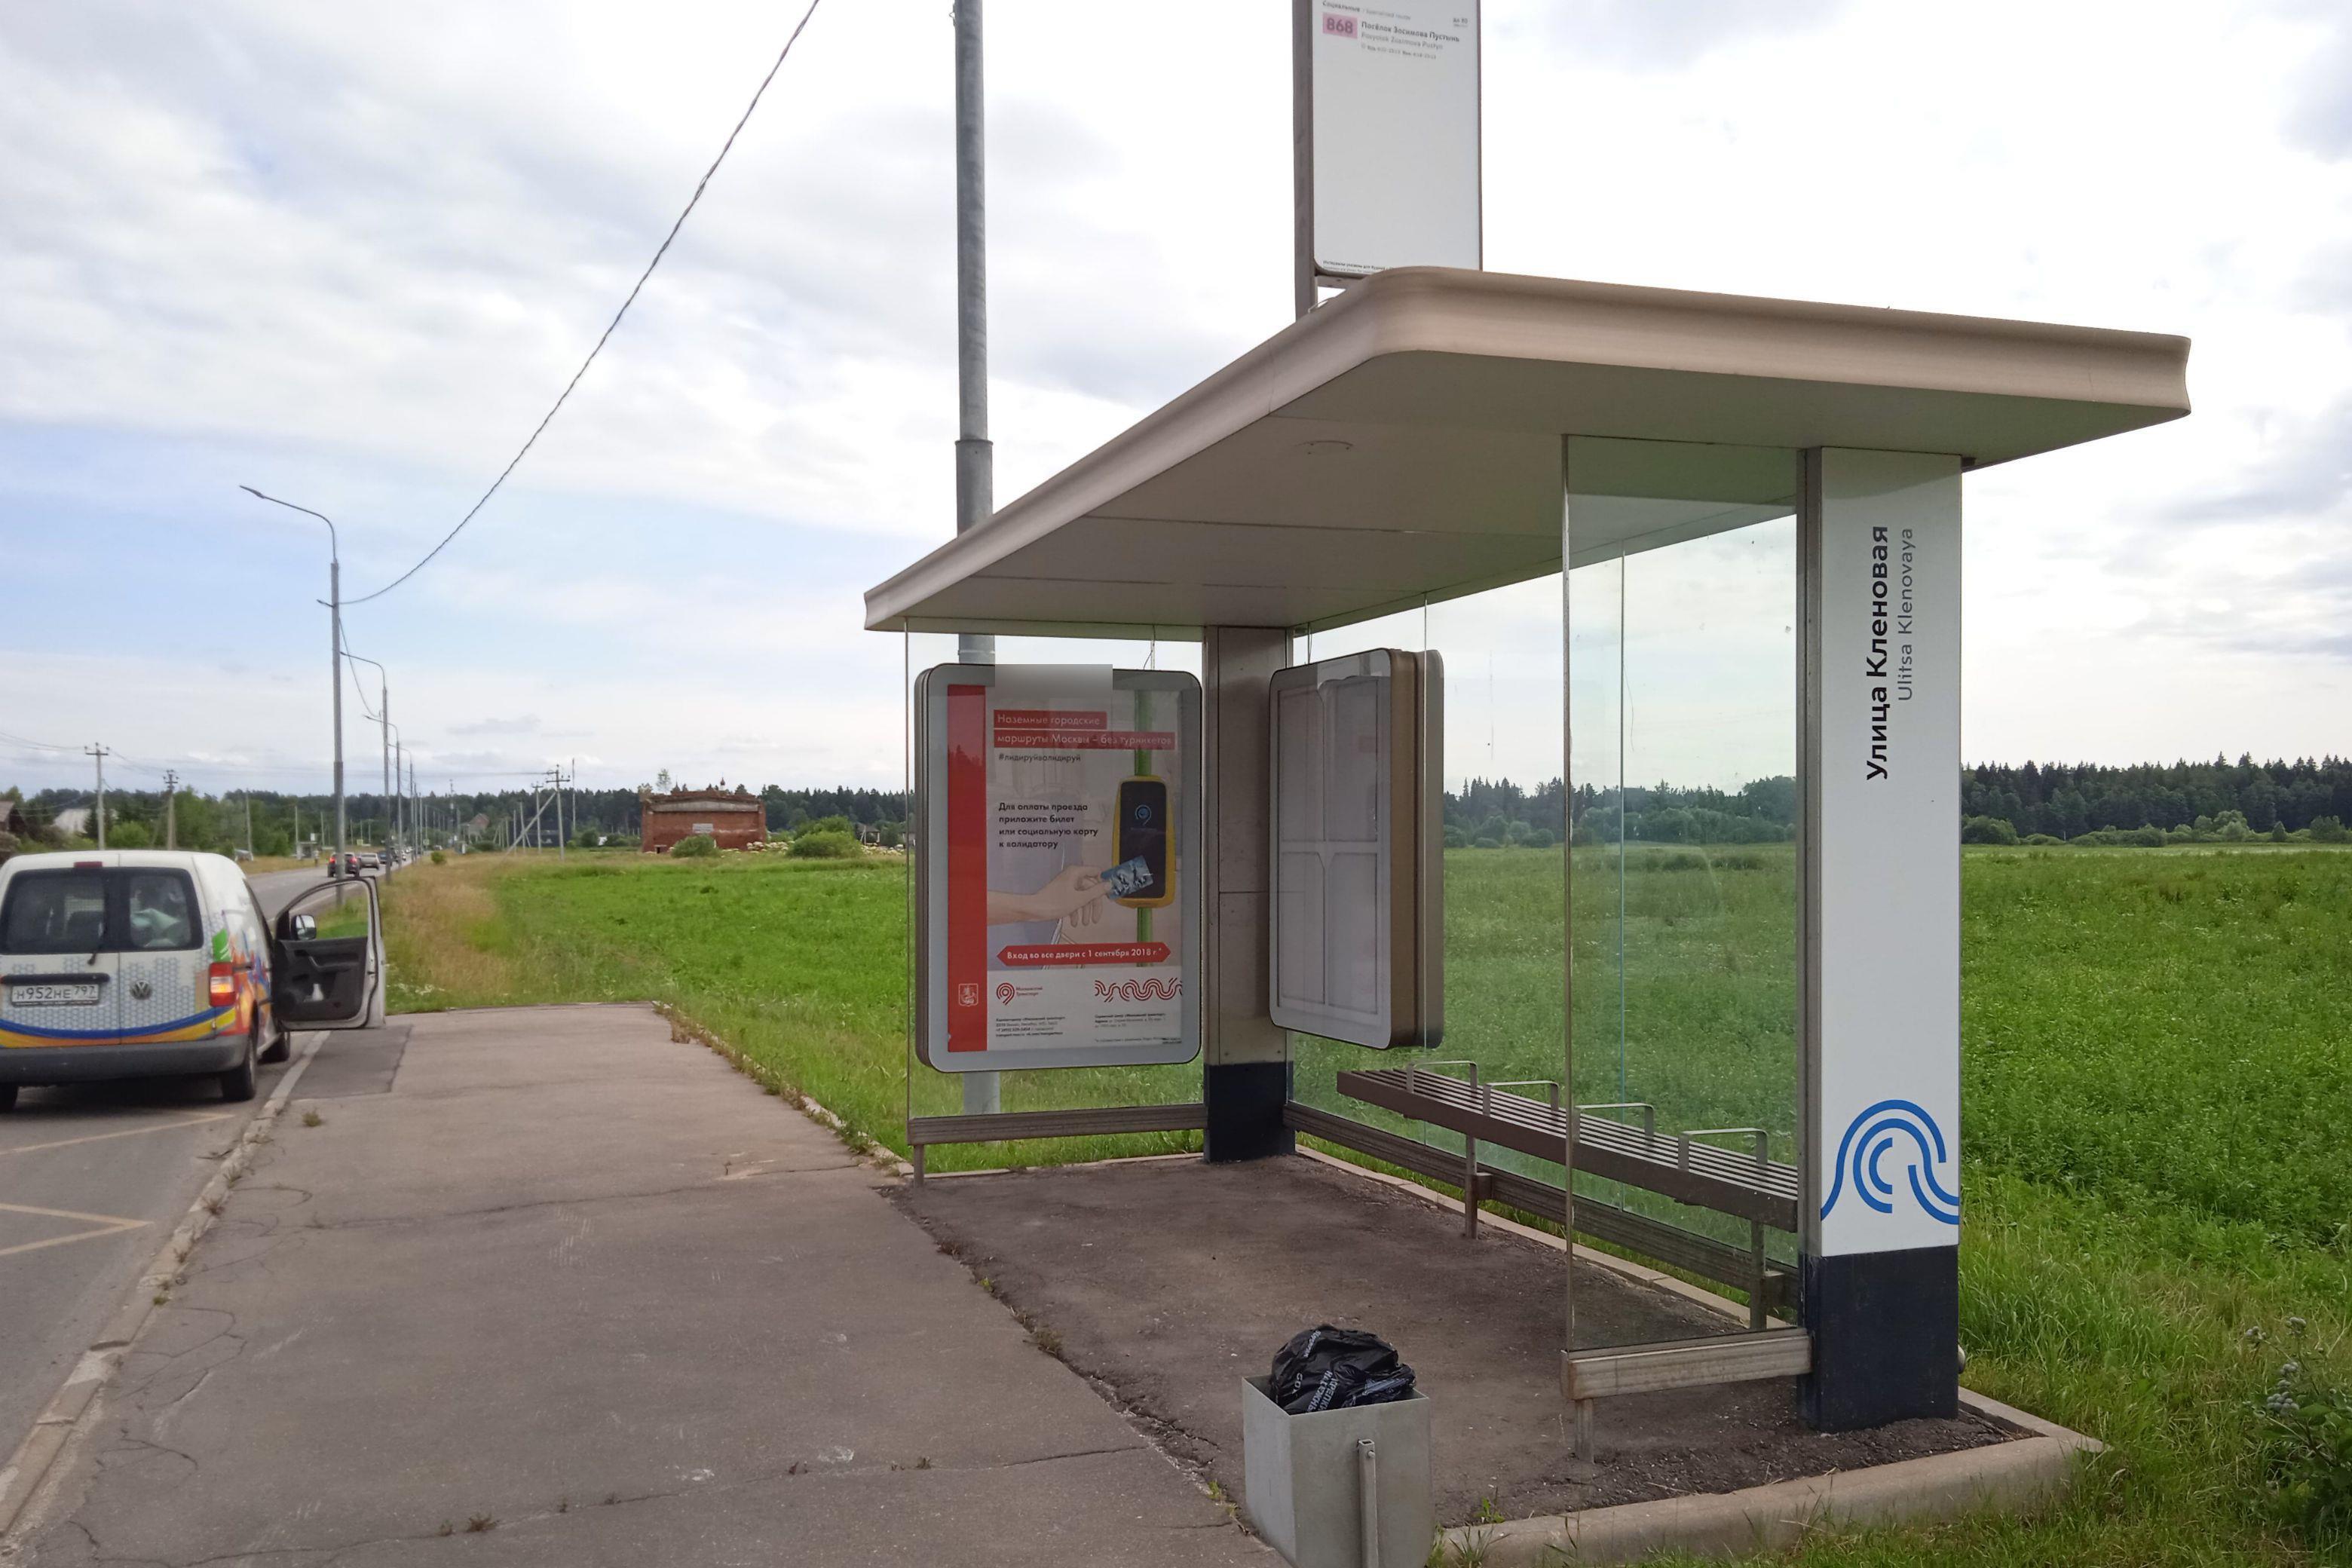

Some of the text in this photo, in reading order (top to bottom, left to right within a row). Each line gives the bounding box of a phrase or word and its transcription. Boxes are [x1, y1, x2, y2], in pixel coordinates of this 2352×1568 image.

[1327, 17, 1353, 34] 868
[1361, 21, 1460, 42] Посёлок Зосимова Пустынь
[1897, 528, 1916, 701] Ulitsa Klenovaya
[1866, 526, 1890, 780] Улица Кленовая
[997, 714, 1101, 727] Наземные городские
[997, 735, 1049, 745] маршруты
[1050, 734, 1090, 743] Москвы
[1101, 734, 1117, 744] без
[1120, 737, 1172, 746] турникетов
[998, 802, 1015, 812] Для
[1051, 804, 1088, 812] проезда
[999, 814, 1075, 825] приложите билет
[1018, 828, 1071, 837] социальную
[1073, 828, 1098, 837] карту
[1006, 841, 1059, 850] валидатору
[1007, 951, 1028, 960] Вход
[1055, 951, 1081, 960] двери
[1095, 948, 1129, 959] сентября
[1131, 948, 1151, 957] 2018
